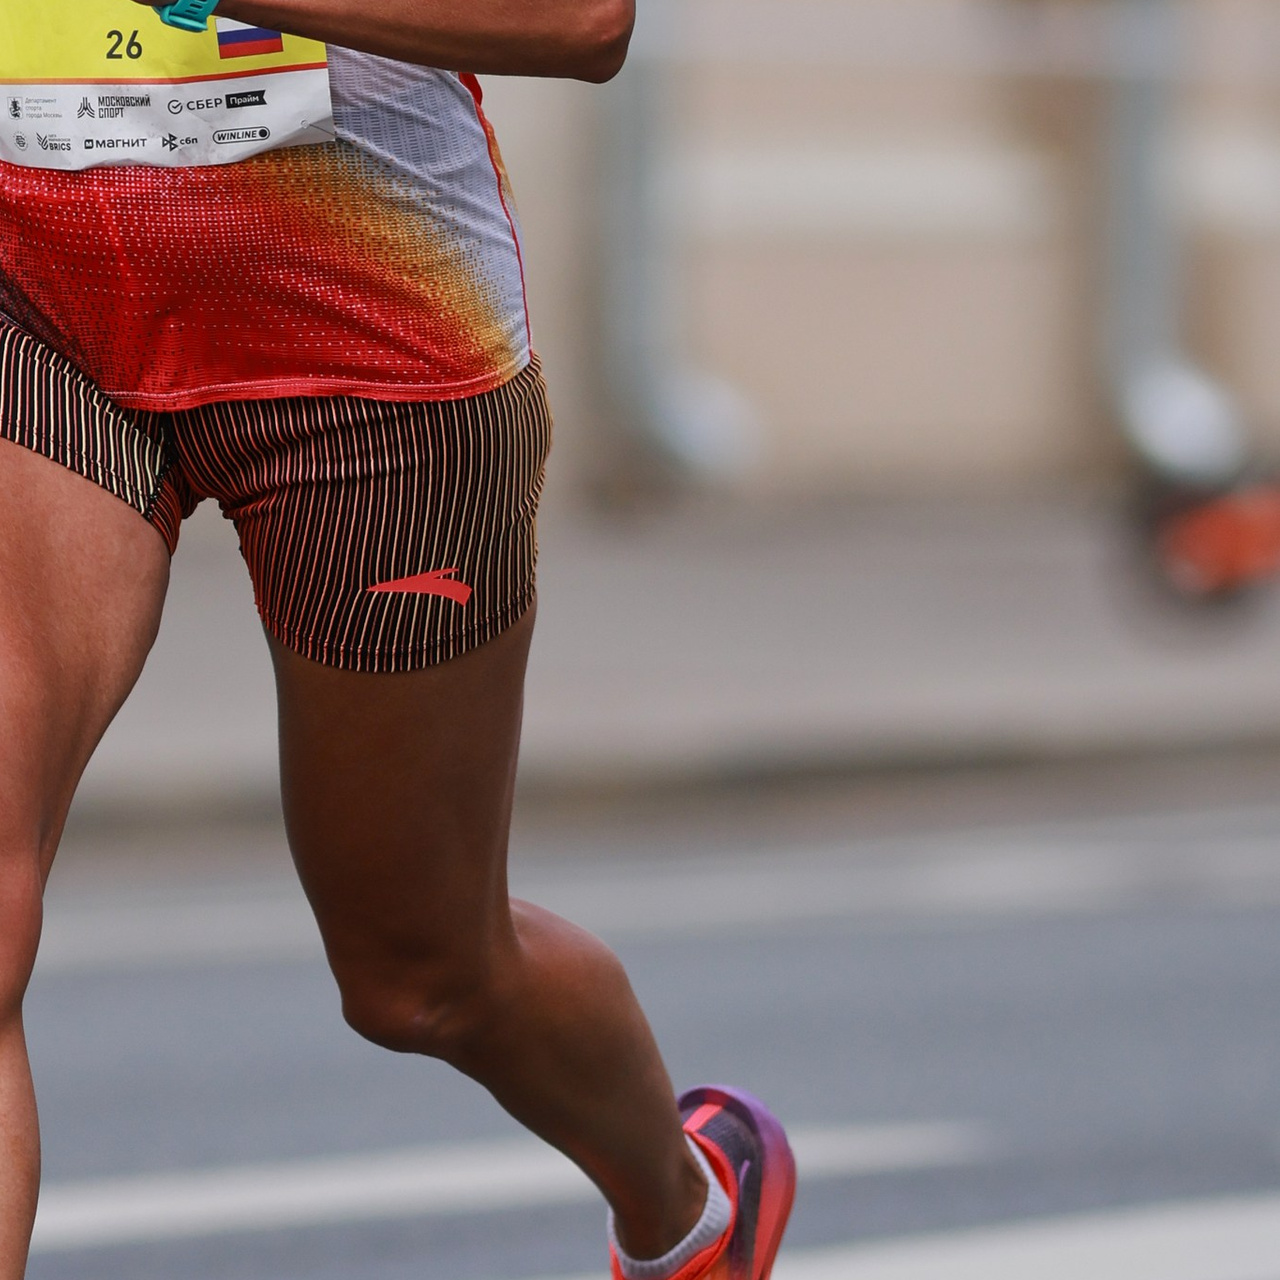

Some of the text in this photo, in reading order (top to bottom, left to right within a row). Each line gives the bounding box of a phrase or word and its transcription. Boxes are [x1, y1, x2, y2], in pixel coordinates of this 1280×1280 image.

[105, 29, 143, 60] 26
[98, 94, 151, 107] МОСКОВСКИЙ
[186, 94, 260, 111] СБЕР Прайм
[98, 107, 124, 118] СПОРТ
[179, 136, 198, 145] сбп
[216, 129, 258, 141] WINLINE
[49, 142, 71, 151] BRICS
[95, 138, 147, 149] магнит
